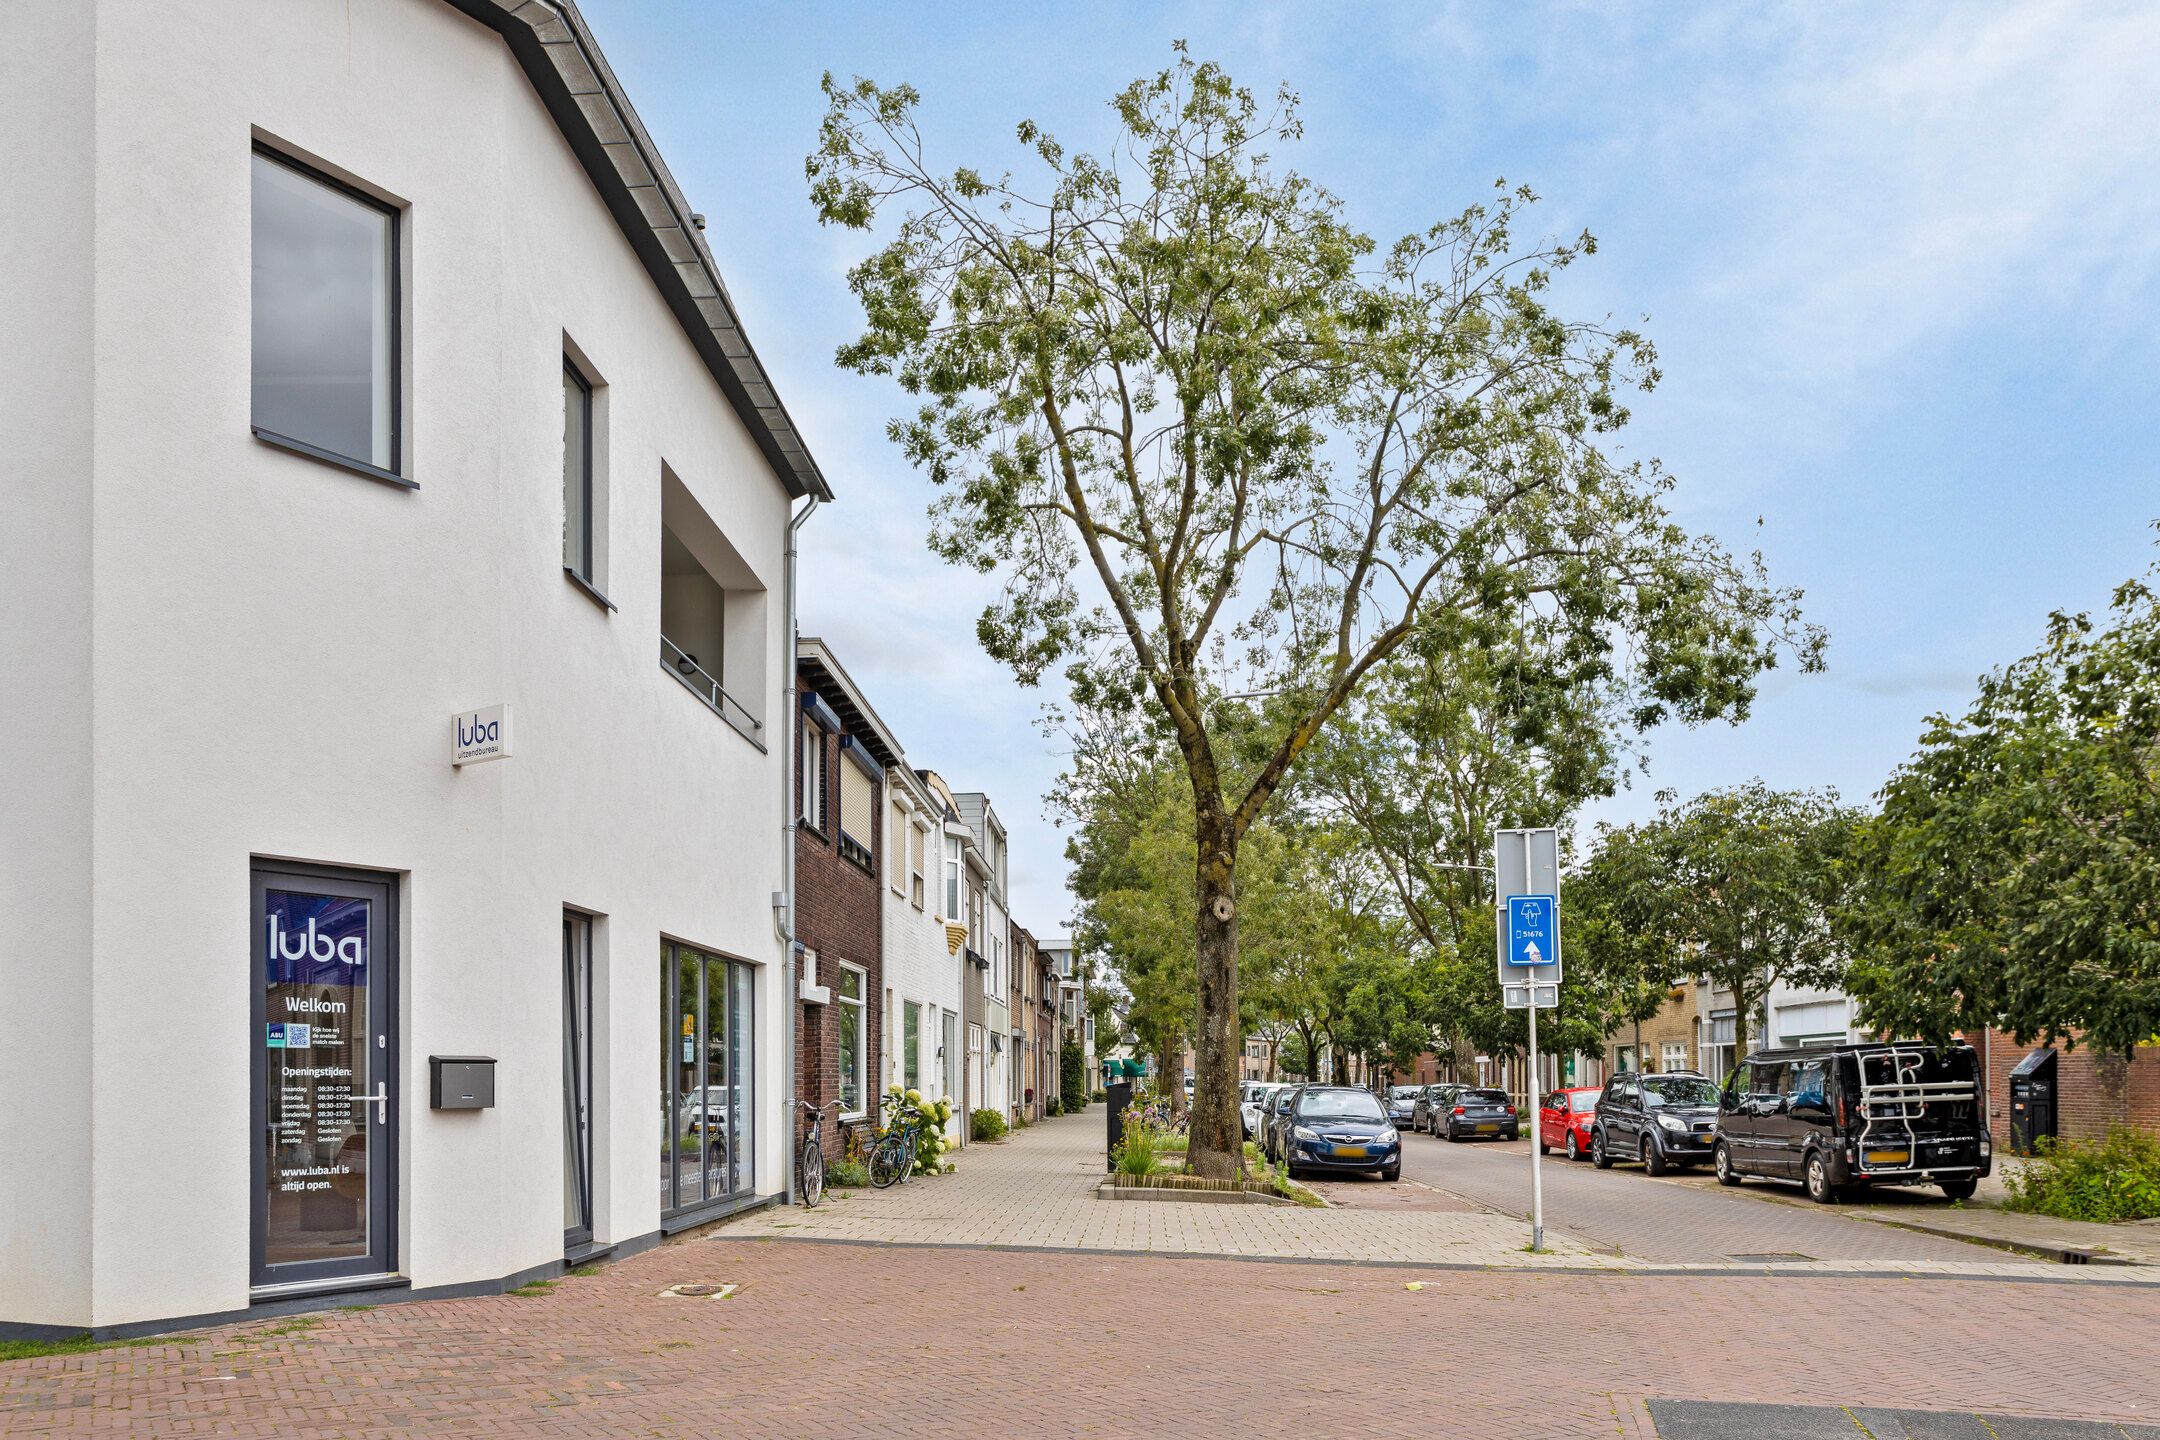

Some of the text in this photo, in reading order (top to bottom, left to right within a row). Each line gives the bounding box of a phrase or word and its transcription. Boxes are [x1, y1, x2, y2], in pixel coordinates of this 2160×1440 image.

[458, 714, 498, 748] luba
[458, 746, 499, 759] uitzendbureau
[271, 915, 361, 965] luba
[286, 997, 346, 1013] Welkom
[282, 1067, 352, 1078] Openingstijden:
[281, 1165, 350, 1177] www.luba.nl is
[281, 1181, 332, 1192] altijd open.
